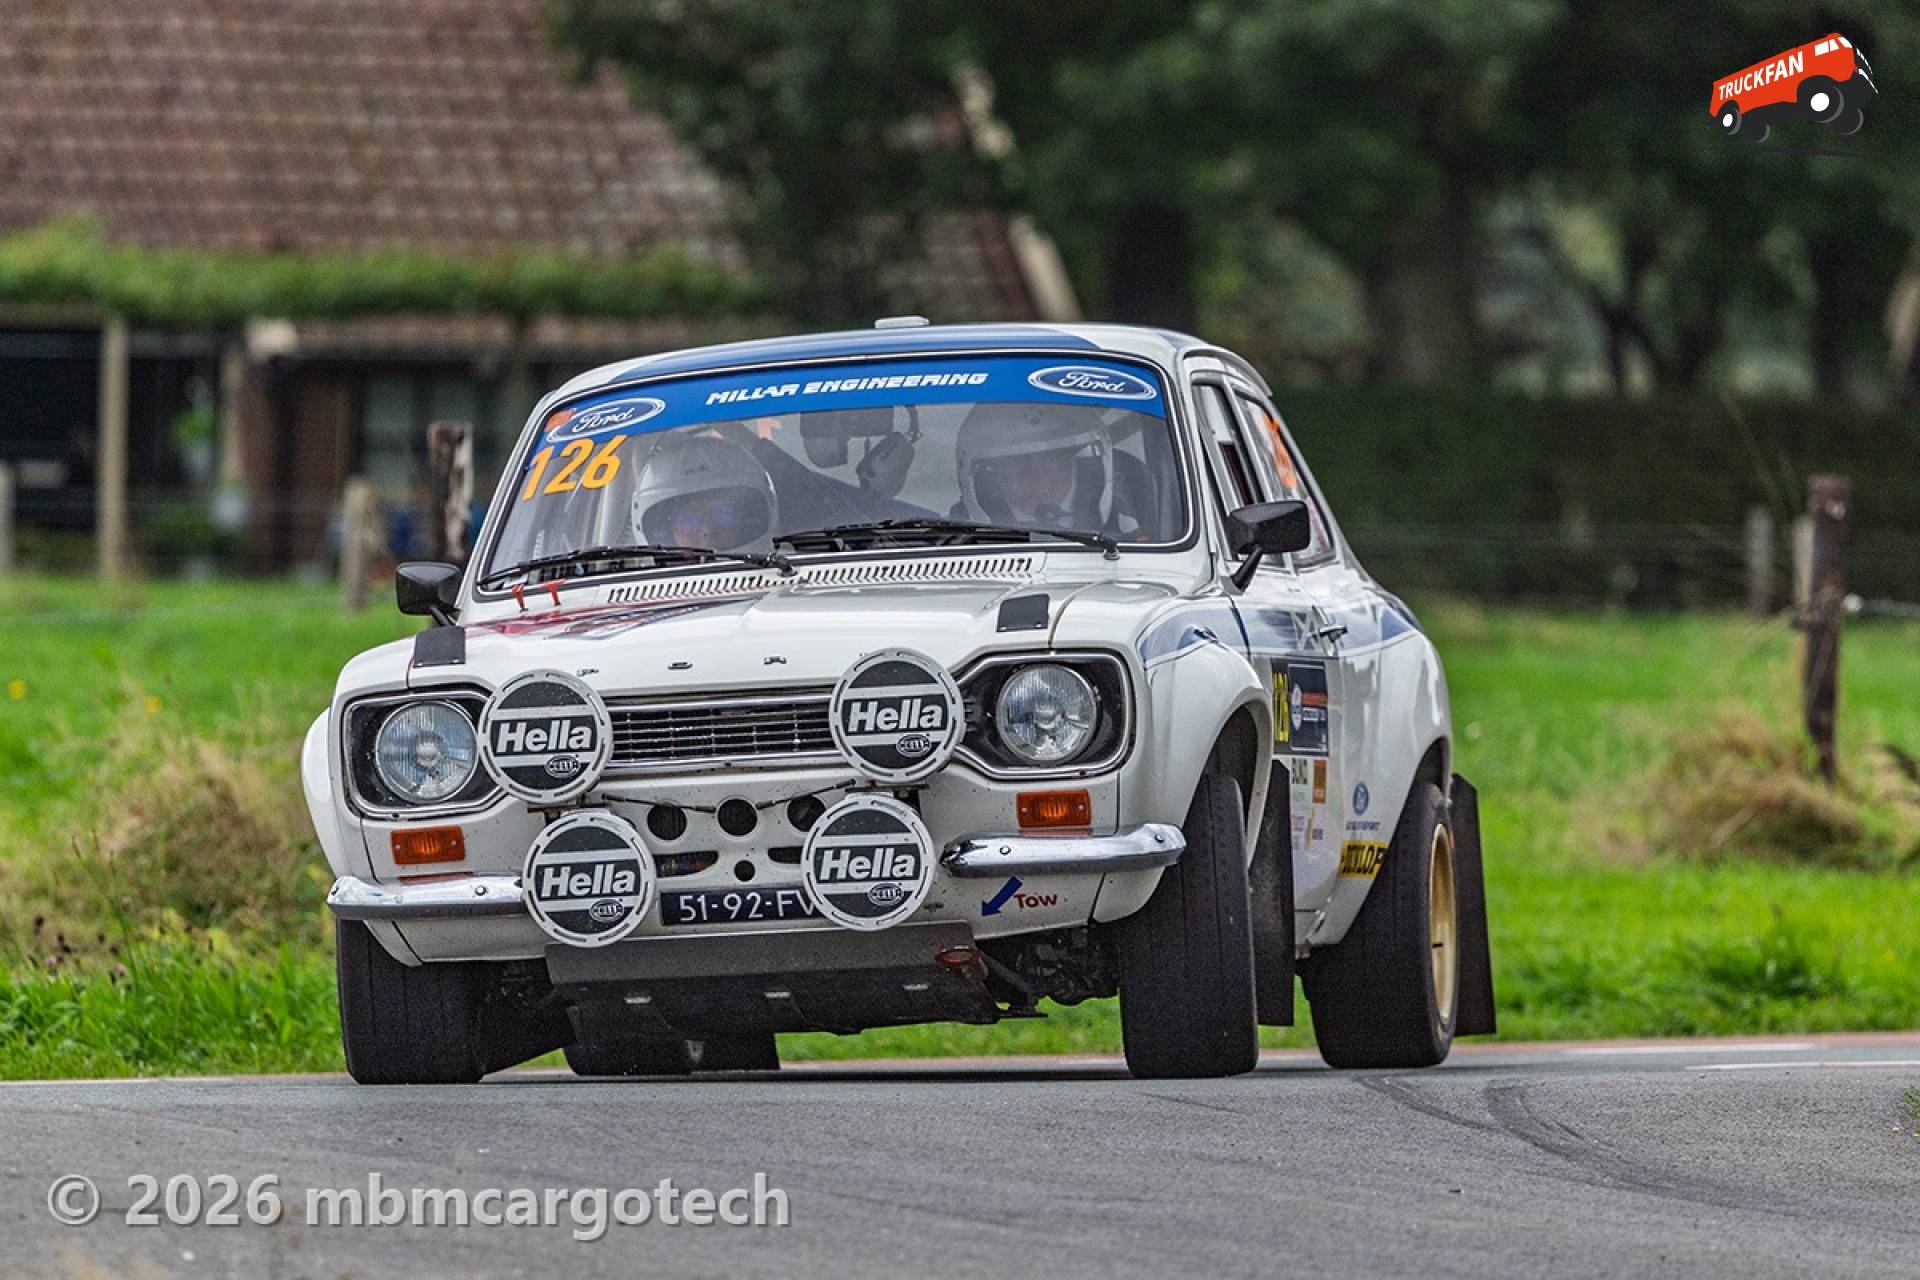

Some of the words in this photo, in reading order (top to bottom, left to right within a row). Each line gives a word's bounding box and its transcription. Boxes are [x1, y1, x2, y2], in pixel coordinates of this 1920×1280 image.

[705, 383, 800, 406] MILLAR
[803, 372, 989, 395] ENGINEERING
[1058, 371, 1125, 393] Ford
[572, 406, 637, 433] Ford
[522, 434, 628, 501] 126
[847, 698, 944, 732] Hella
[496, 719, 593, 753] Hella
[540, 863, 636, 898] Hella
[819, 847, 917, 881] Hella
[679, 889, 816, 922] 51-92-FV
[1013, 893, 1058, 914] Tow
